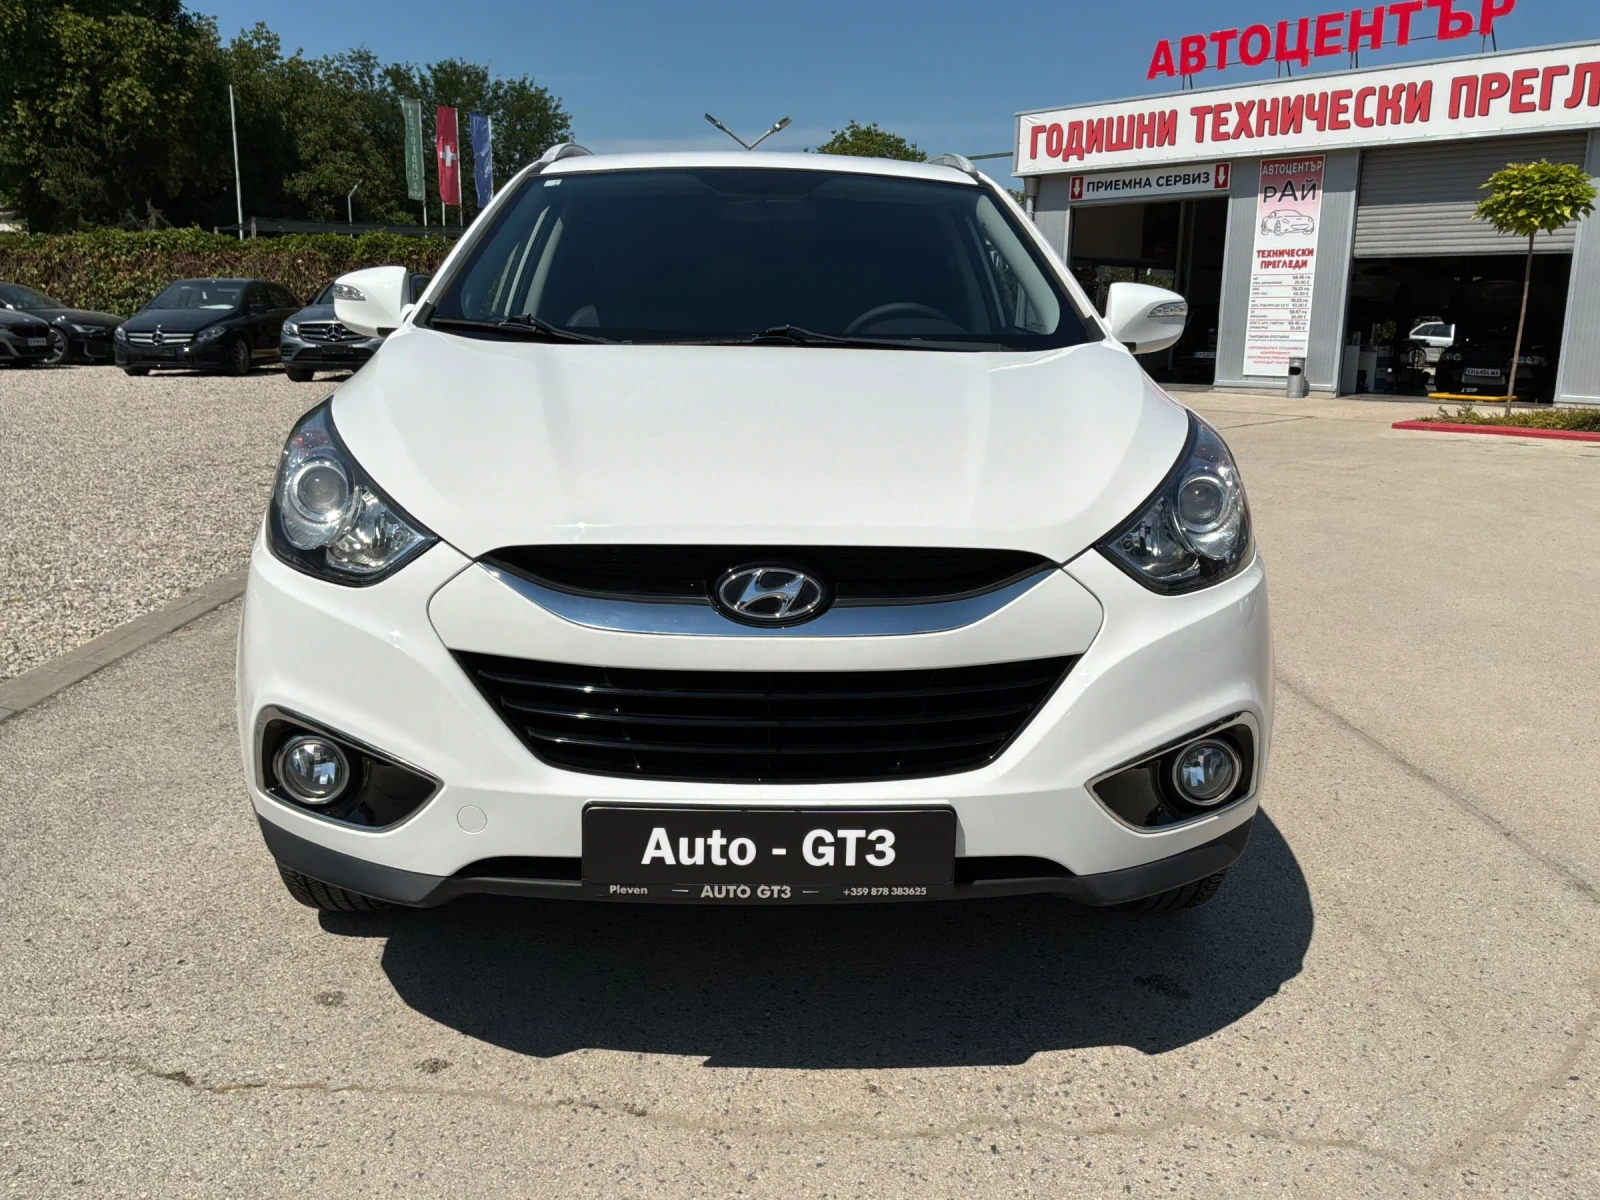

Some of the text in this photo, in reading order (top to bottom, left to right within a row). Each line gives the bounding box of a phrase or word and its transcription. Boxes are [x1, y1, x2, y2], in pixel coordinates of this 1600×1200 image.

[1146, 0, 1516, 81] АВТОЦЕНТЪР
[1029, 61, 1600, 162] ГОДИШНИ ТЕХНИЧЕСКИ ПРЕГЛ
[1261, 160, 1324, 176] АВТОЦЕНТЪР
[1086, 172, 1211, 193] ПРИЕМНА СЕРВИЗ
[1256, 248, 1315, 258] ТЕХНИЧЕСКИ
[1260, 259, 1308, 270] ПРЕГЛЕДИ
[640, 827, 756, 866] Auto
[802, 828, 896, 867] GT3
[609, 884, 927, 899] Pleven AUTO GT3 +359 878 383625
